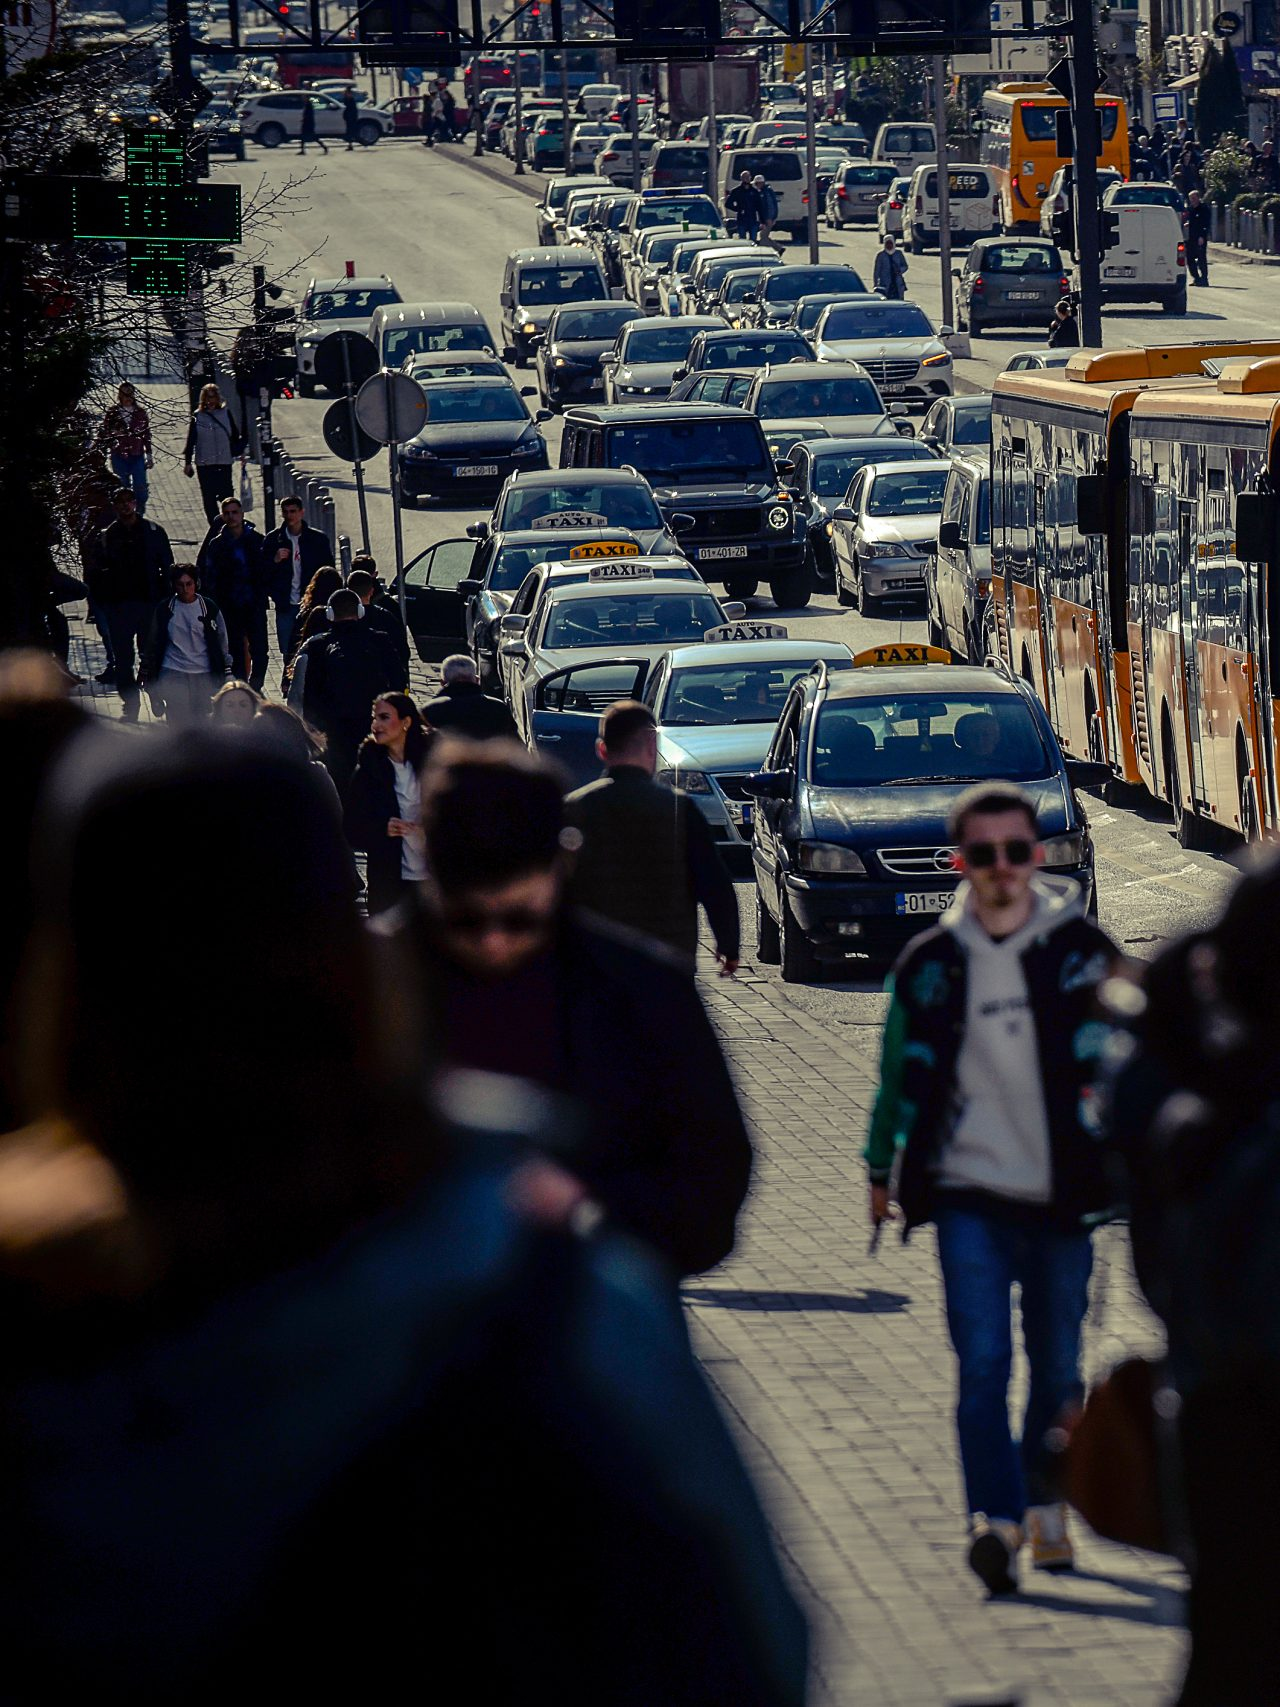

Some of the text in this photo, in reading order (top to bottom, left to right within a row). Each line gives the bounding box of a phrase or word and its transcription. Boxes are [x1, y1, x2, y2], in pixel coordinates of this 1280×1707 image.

[547, 516, 593, 527] TAXI
[582, 545, 626, 557] TAXI
[601, 564, 637, 576] TAXI
[718, 625, 773, 640] TAXI
[873, 648, 929, 662] TAXI
